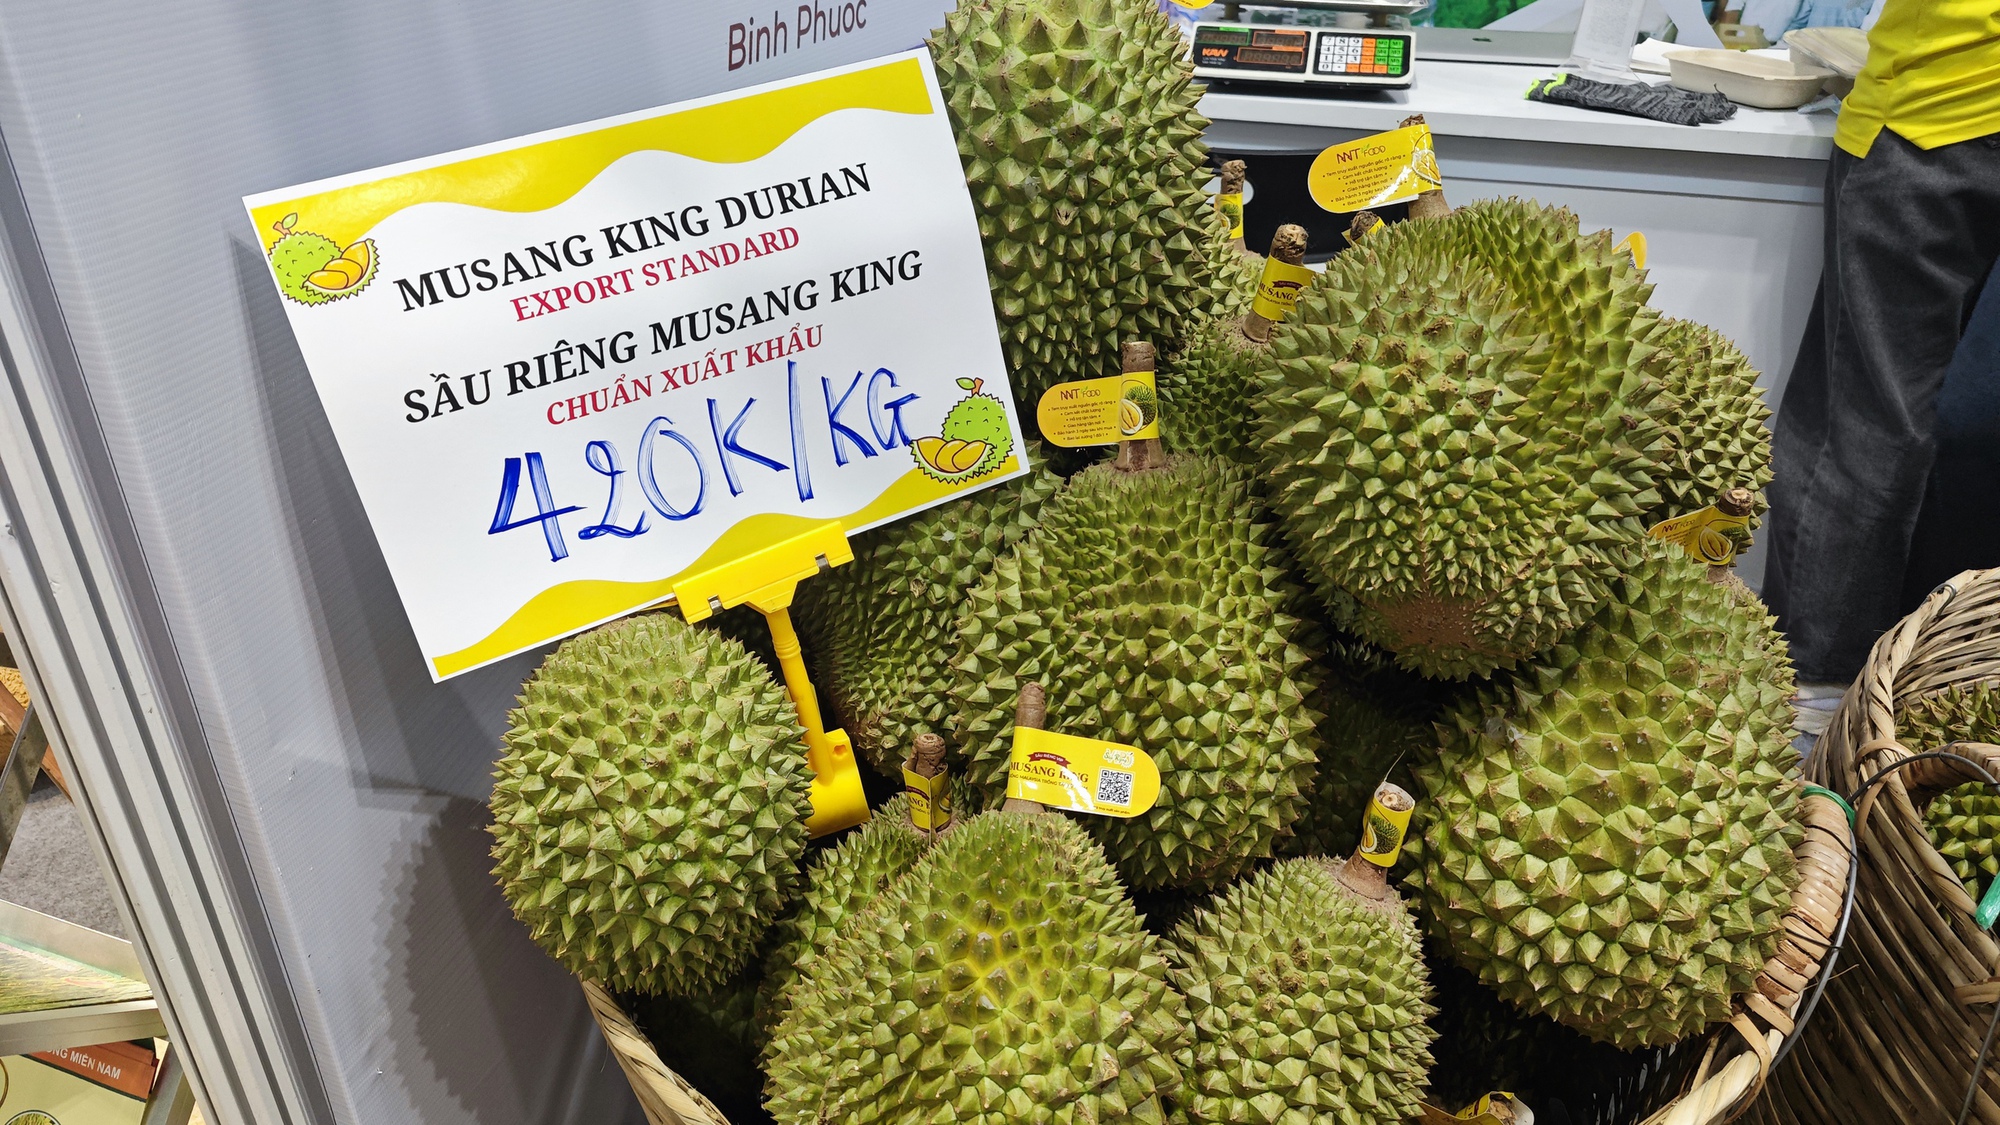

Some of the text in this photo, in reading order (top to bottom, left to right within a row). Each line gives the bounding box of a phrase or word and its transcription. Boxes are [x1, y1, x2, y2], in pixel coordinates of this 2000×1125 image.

[728, 11, 788, 71] Binh
[393, 162, 871, 312] MUSANG KING DURIAN
[510, 226, 800, 322] EXPORT STANDARD
[403, 250, 923, 423] SẦU RIÊNG MUSANG KING
[546, 322, 823, 425] CHUẨN XUẤT KHẨU
[97, 1061, 121, 1080] NAM
